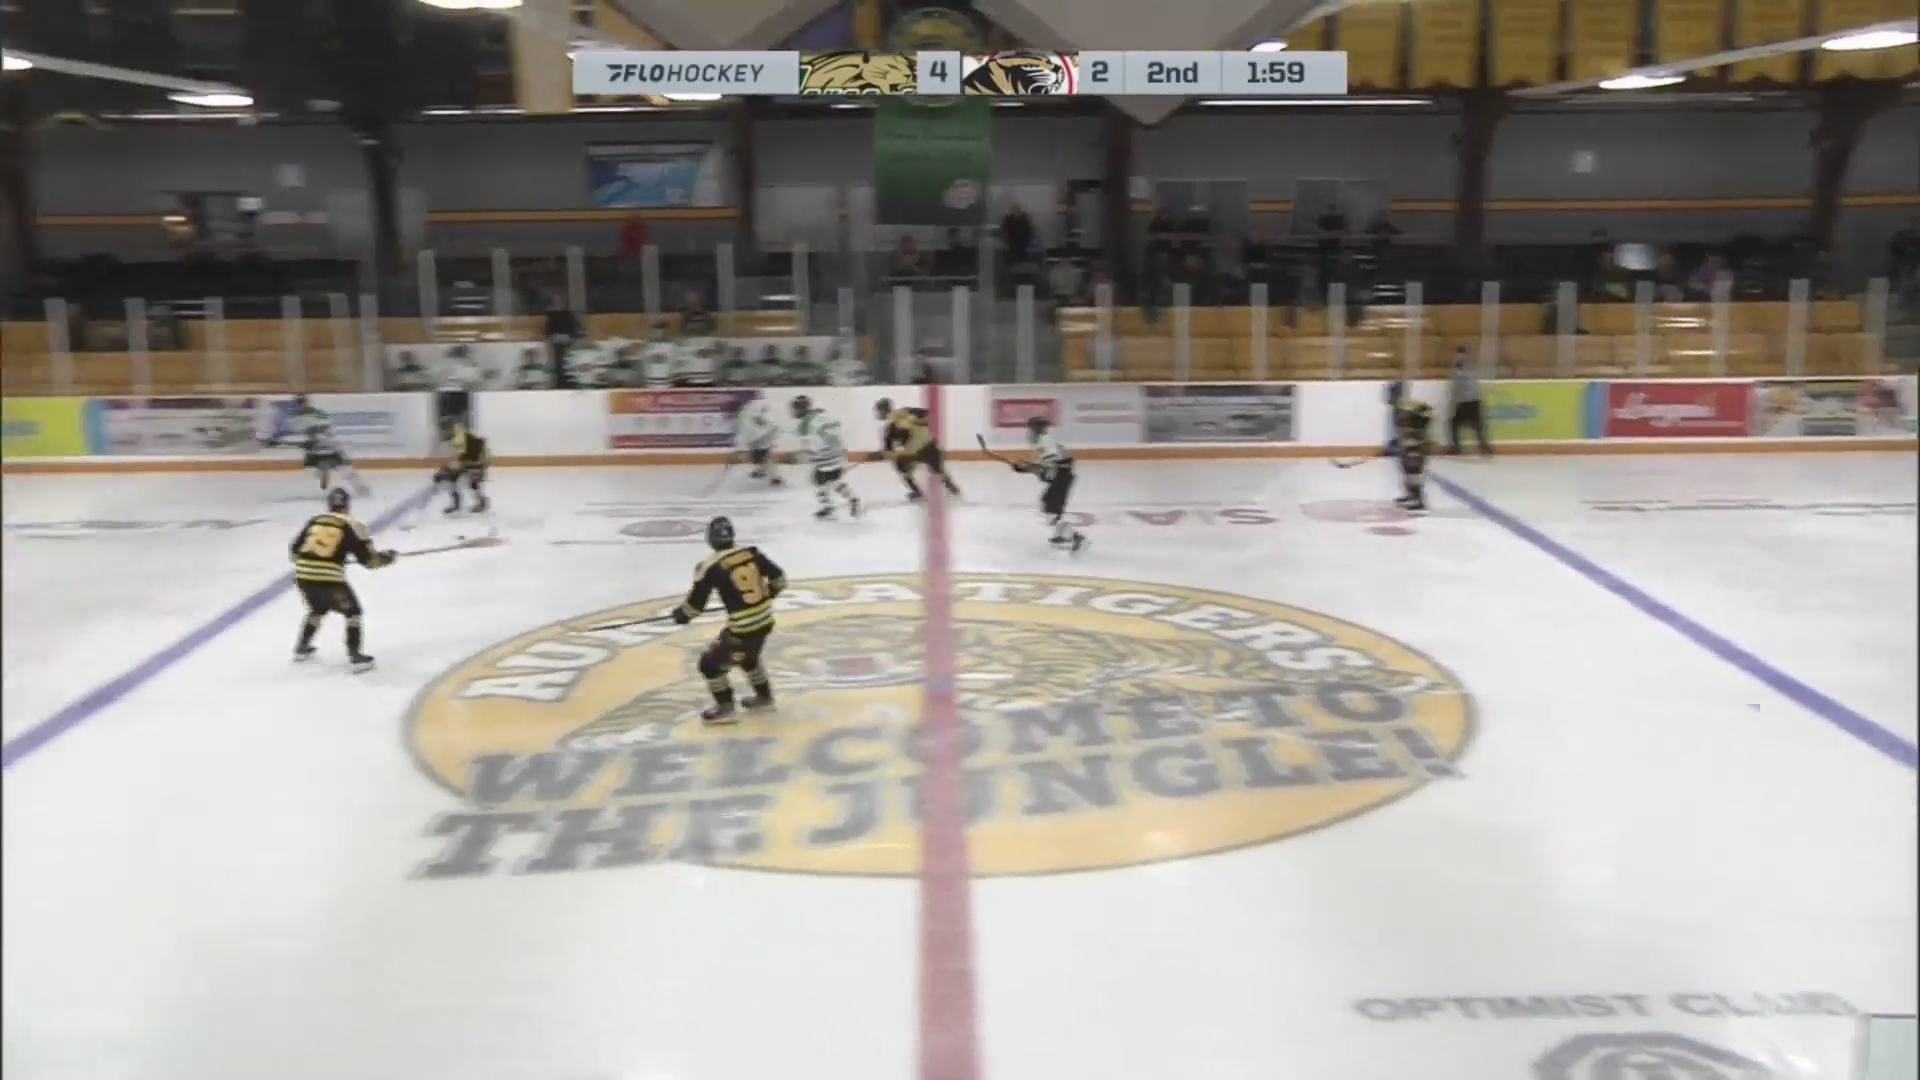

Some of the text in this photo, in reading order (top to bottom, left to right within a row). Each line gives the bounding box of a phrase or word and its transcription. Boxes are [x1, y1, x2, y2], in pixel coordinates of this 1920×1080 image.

[955, 581, 1385, 673] TIGERS
[412, 726, 1462, 880] THE JUNGLE!
[468, 680, 1410, 803] WELCOME TO
